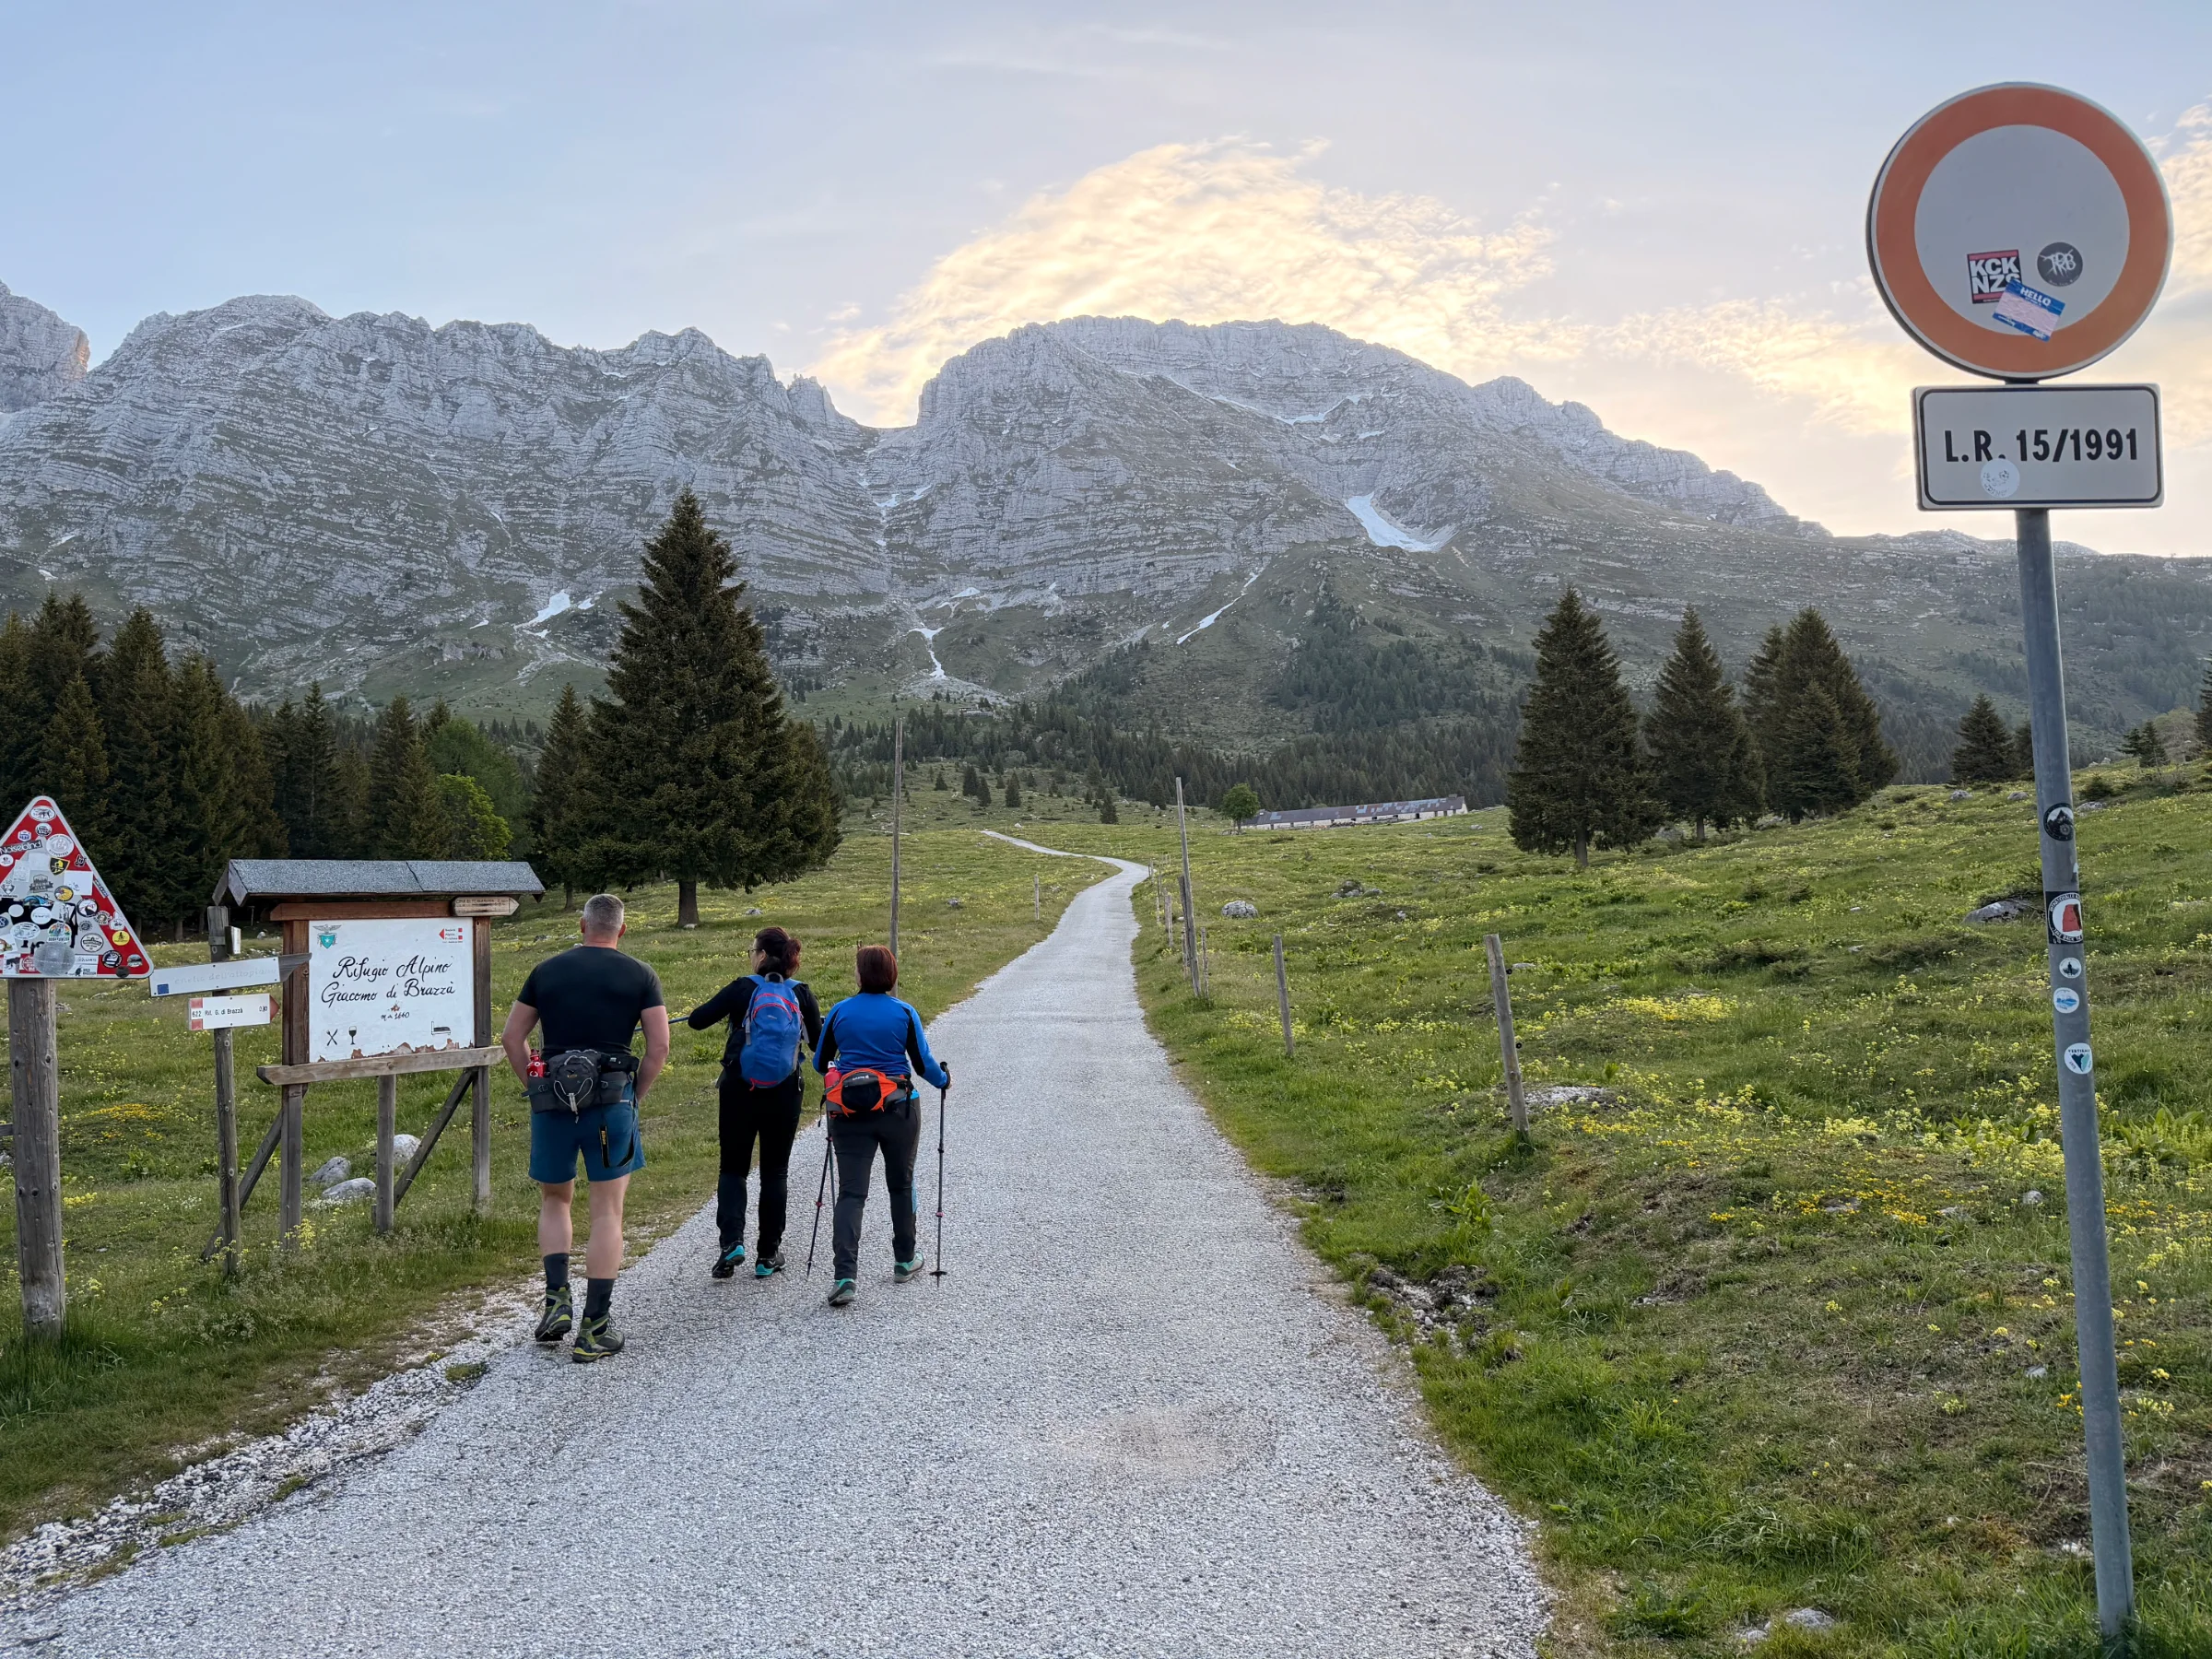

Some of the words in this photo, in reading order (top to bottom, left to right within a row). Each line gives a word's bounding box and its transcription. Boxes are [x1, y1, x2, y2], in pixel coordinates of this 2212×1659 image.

[1969, 256, 2020, 277] KCK
[2019, 287, 2052, 307] HELLO
[1944, 429, 2006, 463] L.R.
[2016, 428, 2137, 463] 15/1991
[333, 956, 390, 982] Rifugio
[396, 955, 453, 982] Alpino
[321, 982, 378, 1008] Giacomo
[386, 983, 399, 998] di
[404, 978, 455, 997] Brazzà
